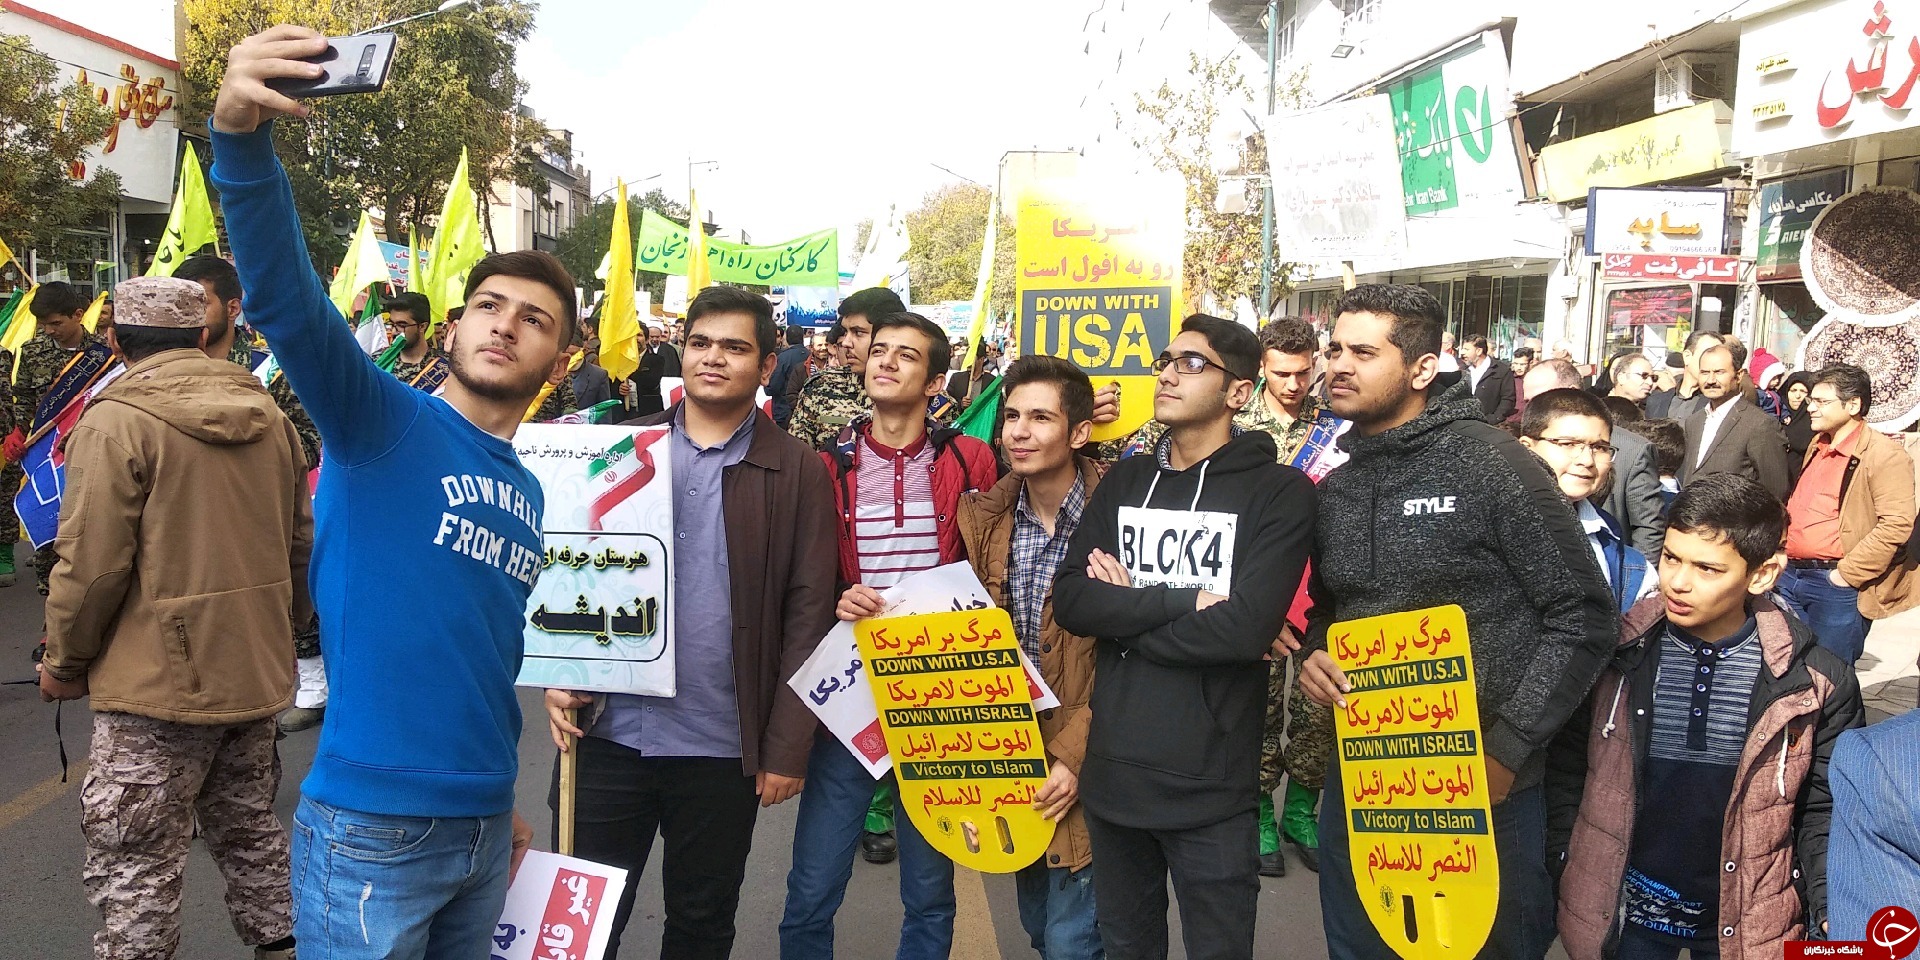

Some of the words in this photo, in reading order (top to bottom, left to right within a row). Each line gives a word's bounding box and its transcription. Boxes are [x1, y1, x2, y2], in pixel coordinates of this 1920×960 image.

[1417, 90, 1453, 170] بانک
[1415, 190, 1429, 205] Iran
[1428, 186, 1448, 204] Bank
[1768, 196, 1795, 216] سایه
[1796, 190, 1833, 213] عکاسی
[1627, 211, 1701, 247] سایه
[641, 233, 688, 269] زنجان
[707, 247, 725, 265] اه
[728, 250, 752, 269] راه
[756, 238, 829, 280] کارکنان
[1024, 256, 1067, 277] است
[1072, 253, 1118, 282] افول
[1125, 259, 1143, 280] به
[1150, 262, 1174, 281] رو
[1645, 257, 1678, 275] نت
[1677, 257, 1738, 280] کافی
[1036, 295, 1097, 312] DOWN
[1104, 293, 1159, 311] WITH
[1035, 312, 1155, 368] USA
[517, 446, 538, 458] ناحیه
[539, 445, 567, 458] پرورش
[576, 446, 604, 460] آموزش
[604, 451, 622, 465] اداره
[441, 474, 544, 552] DOWNHIL
[1403, 496, 1457, 516] STYLE
[433, 512, 506, 568] FROM
[505, 542, 543, 588] HER
[558, 546, 590, 568] حرفه
[594, 547, 648, 569] هنرستان
[530, 594, 657, 644] اندیشه
[960, 618, 1002, 648] مرگ
[870, 626, 930, 657] امریکا
[938, 632, 955, 652] بر
[1335, 628, 1386, 667] امریکا
[1391, 634, 1408, 660] بر
[1413, 615, 1451, 655] مرگ
[809, 643, 863, 706] مریکا
[876, 658, 925, 674] DOWN
[926, 655, 968, 671] WITH
[971, 651, 1014, 667] U.S.A
[1347, 669, 1379, 690] OWN
[1382, 666, 1418, 685] WITH
[1422, 659, 1462, 680] U.S.A
[887, 677, 955, 708] لامریکا
[960, 673, 1015, 703] الموت
[888, 710, 934, 726] DOWN
[935, 708, 974, 724] WITH
[975, 706, 1030, 721] ISRAEL
[1346, 696, 1404, 735] لامریکا
[1408, 689, 1459, 729] الموت
[900, 730, 974, 760] لاسرائیل
[978, 728, 1032, 756] الموت
[1345, 739, 1384, 757] DOWN
[1386, 737, 1420, 755] WITH
[1422, 734, 1474, 754] ISRAEL
[912, 763, 967, 778] Victory
[971, 762, 987, 774] to
[992, 761, 1034, 774] Islam
[1422, 763, 1475, 804] الموت
[1353, 766, 1417, 806] لاسرائیل
[923, 784, 982, 818] للاسلام
[1361, 810, 1410, 832] Victory
[1414, 811, 1430, 829] to
[1432, 810, 1476, 829] Islam
[1367, 842, 1422, 886] للاسلام
[562, 875, 593, 926] غیر
[493, 923, 526, 951] به
[1643, 920, 1697, 938] QUALITY
